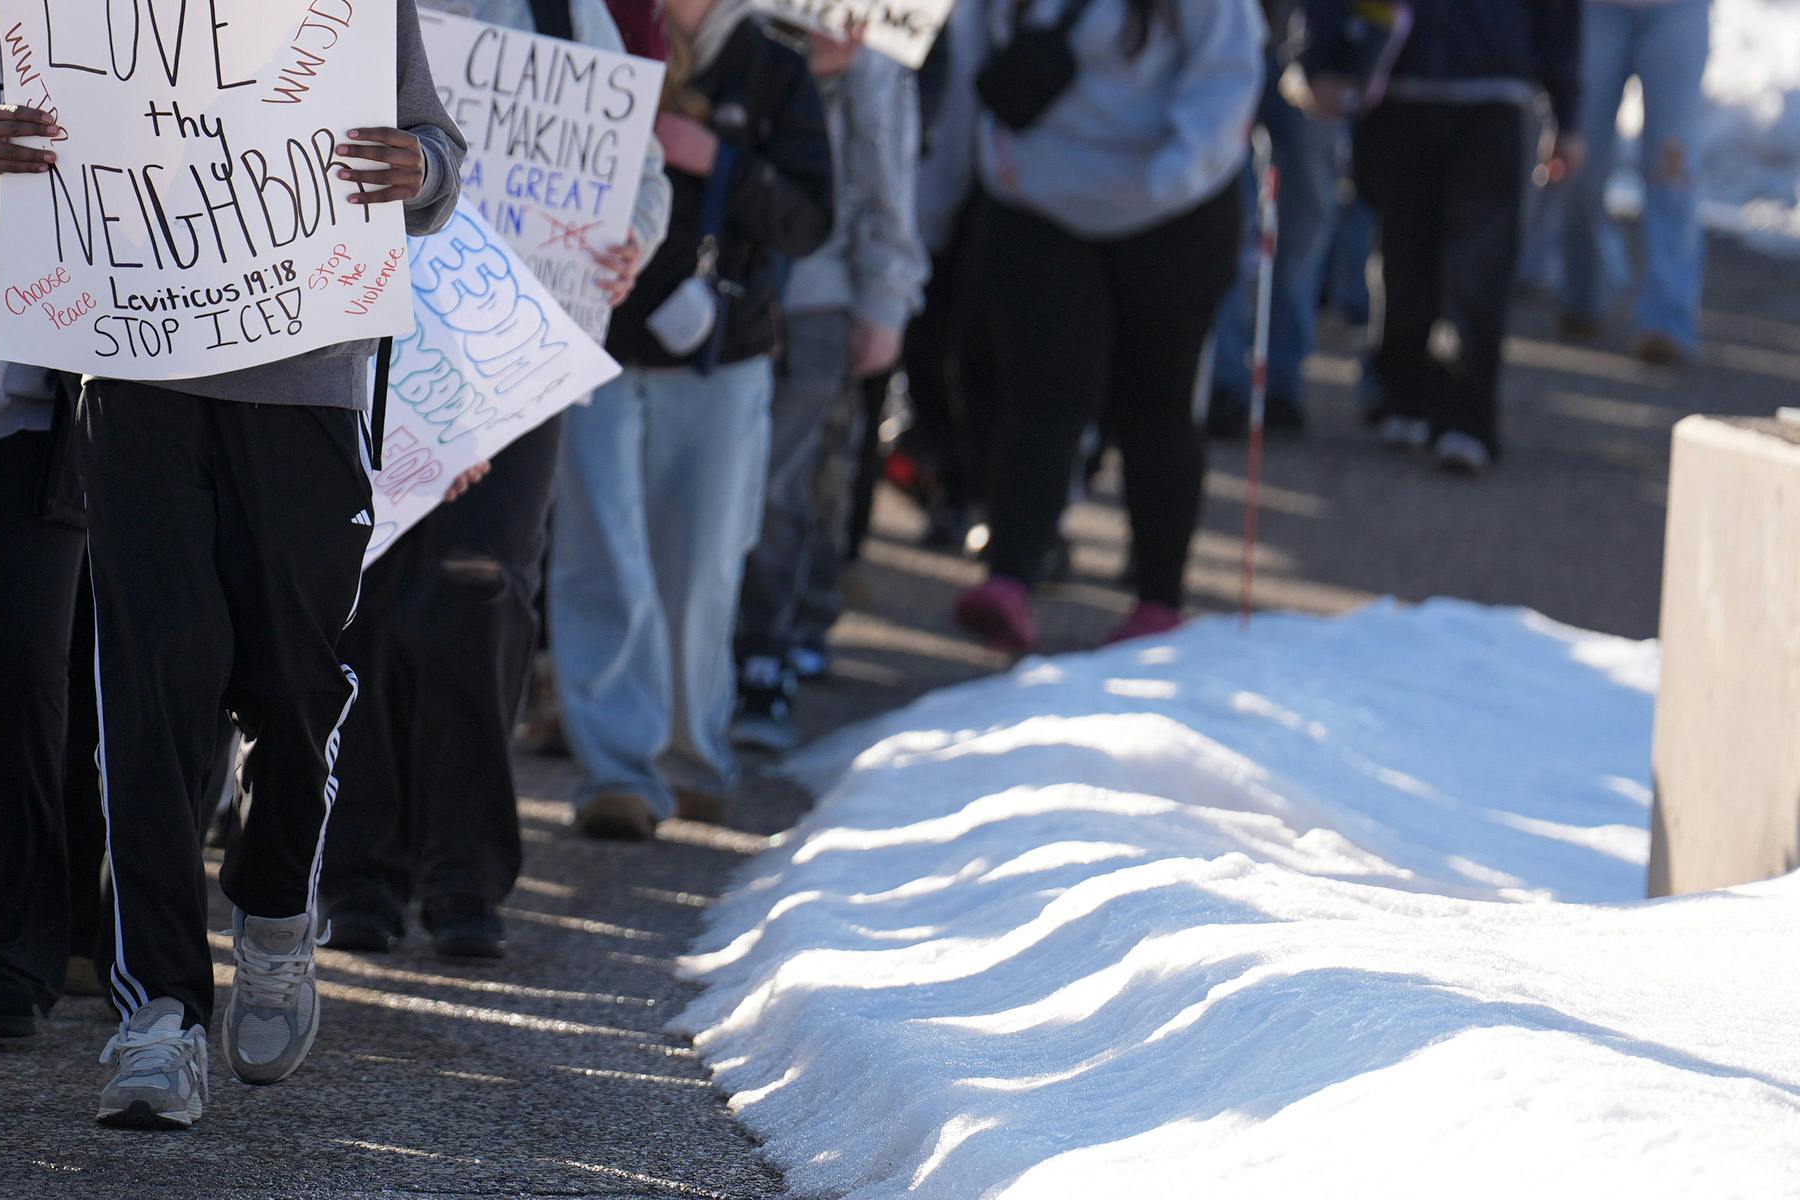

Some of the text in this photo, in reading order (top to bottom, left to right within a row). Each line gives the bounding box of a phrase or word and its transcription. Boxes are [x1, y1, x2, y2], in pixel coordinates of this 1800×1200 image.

[465, 26, 637, 124] CLAIMS
[144, 100, 236, 182] thy
[483, 98, 619, 184] MAKING
[49, 128, 371, 270] NEIGHBOR
[505, 161, 613, 217] GREAT
[4, 265, 71, 316] Choose
[110, 258, 298, 312] Leviticus 19:18
[309, 241, 351, 291] Stop
[339, 261, 367, 289] the
[344, 247, 406, 317] Violence
[43, 290, 97, 331] Peace
[94, 286, 303, 359] STOP ICE!
[375, 425, 444, 506] FOR
